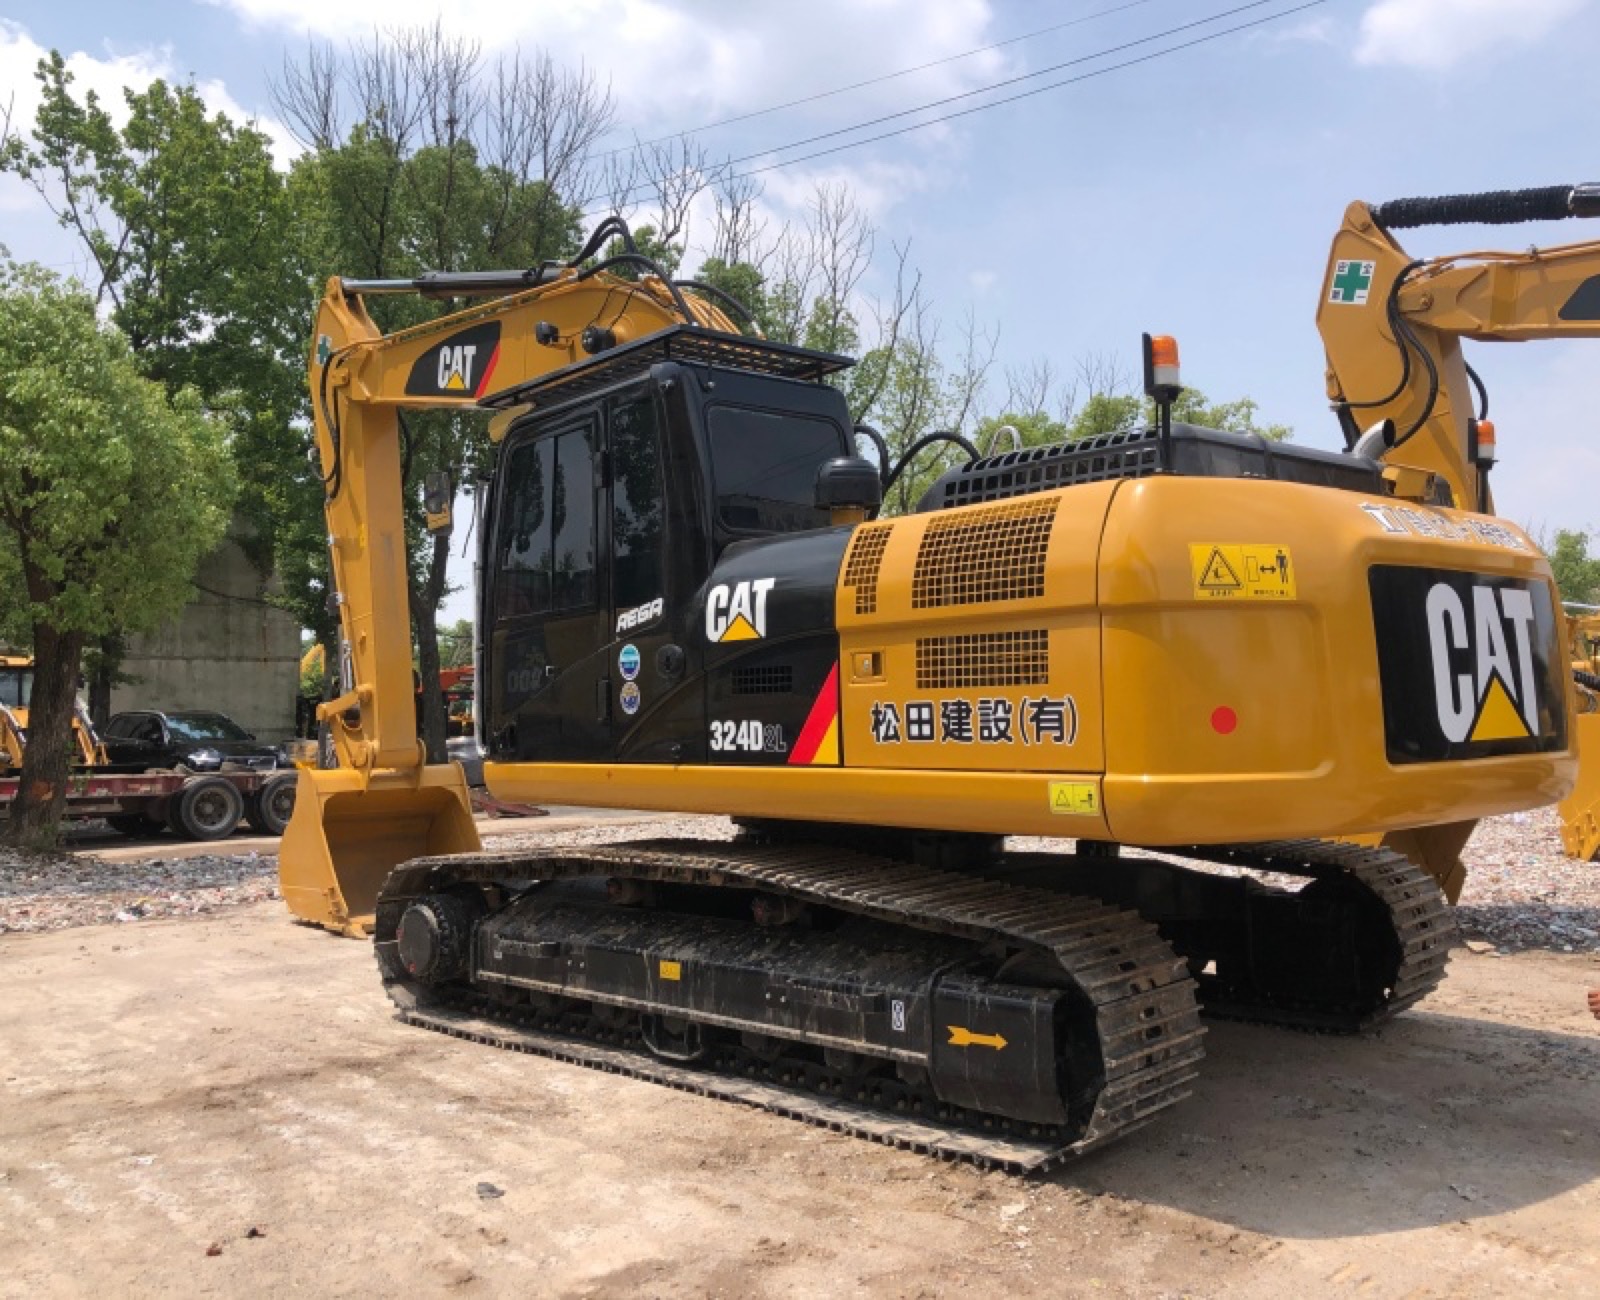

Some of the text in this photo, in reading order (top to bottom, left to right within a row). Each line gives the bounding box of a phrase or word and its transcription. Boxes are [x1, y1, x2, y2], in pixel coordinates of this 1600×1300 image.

[437, 345, 476, 390] CAT
[706, 578, 775, 642] CAT
[1425, 582, 1539, 743] CAT
[870, 695, 1078, 745] 松田建設(有)
